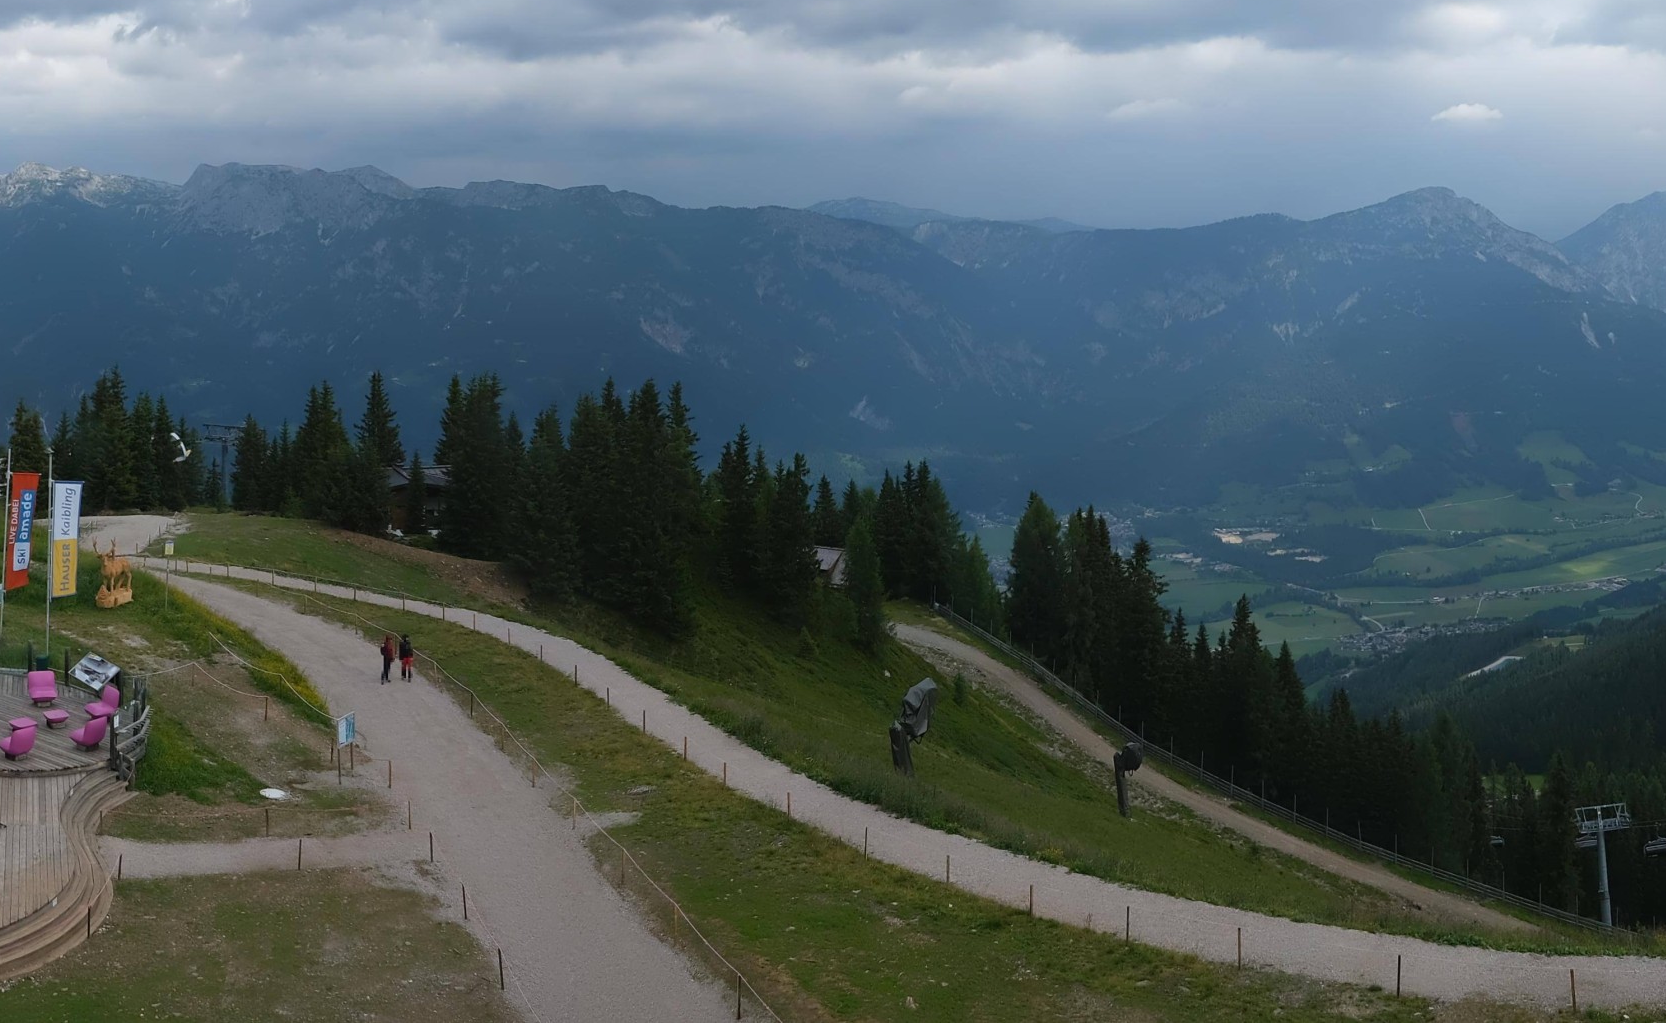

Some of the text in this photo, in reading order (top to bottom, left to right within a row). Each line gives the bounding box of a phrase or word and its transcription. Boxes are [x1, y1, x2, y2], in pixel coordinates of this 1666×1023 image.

[8, 499, 20, 545] LIVE DABEI
[60, 487, 77, 591] HAUSER Kaibling
[17, 548, 27, 564] Ski
